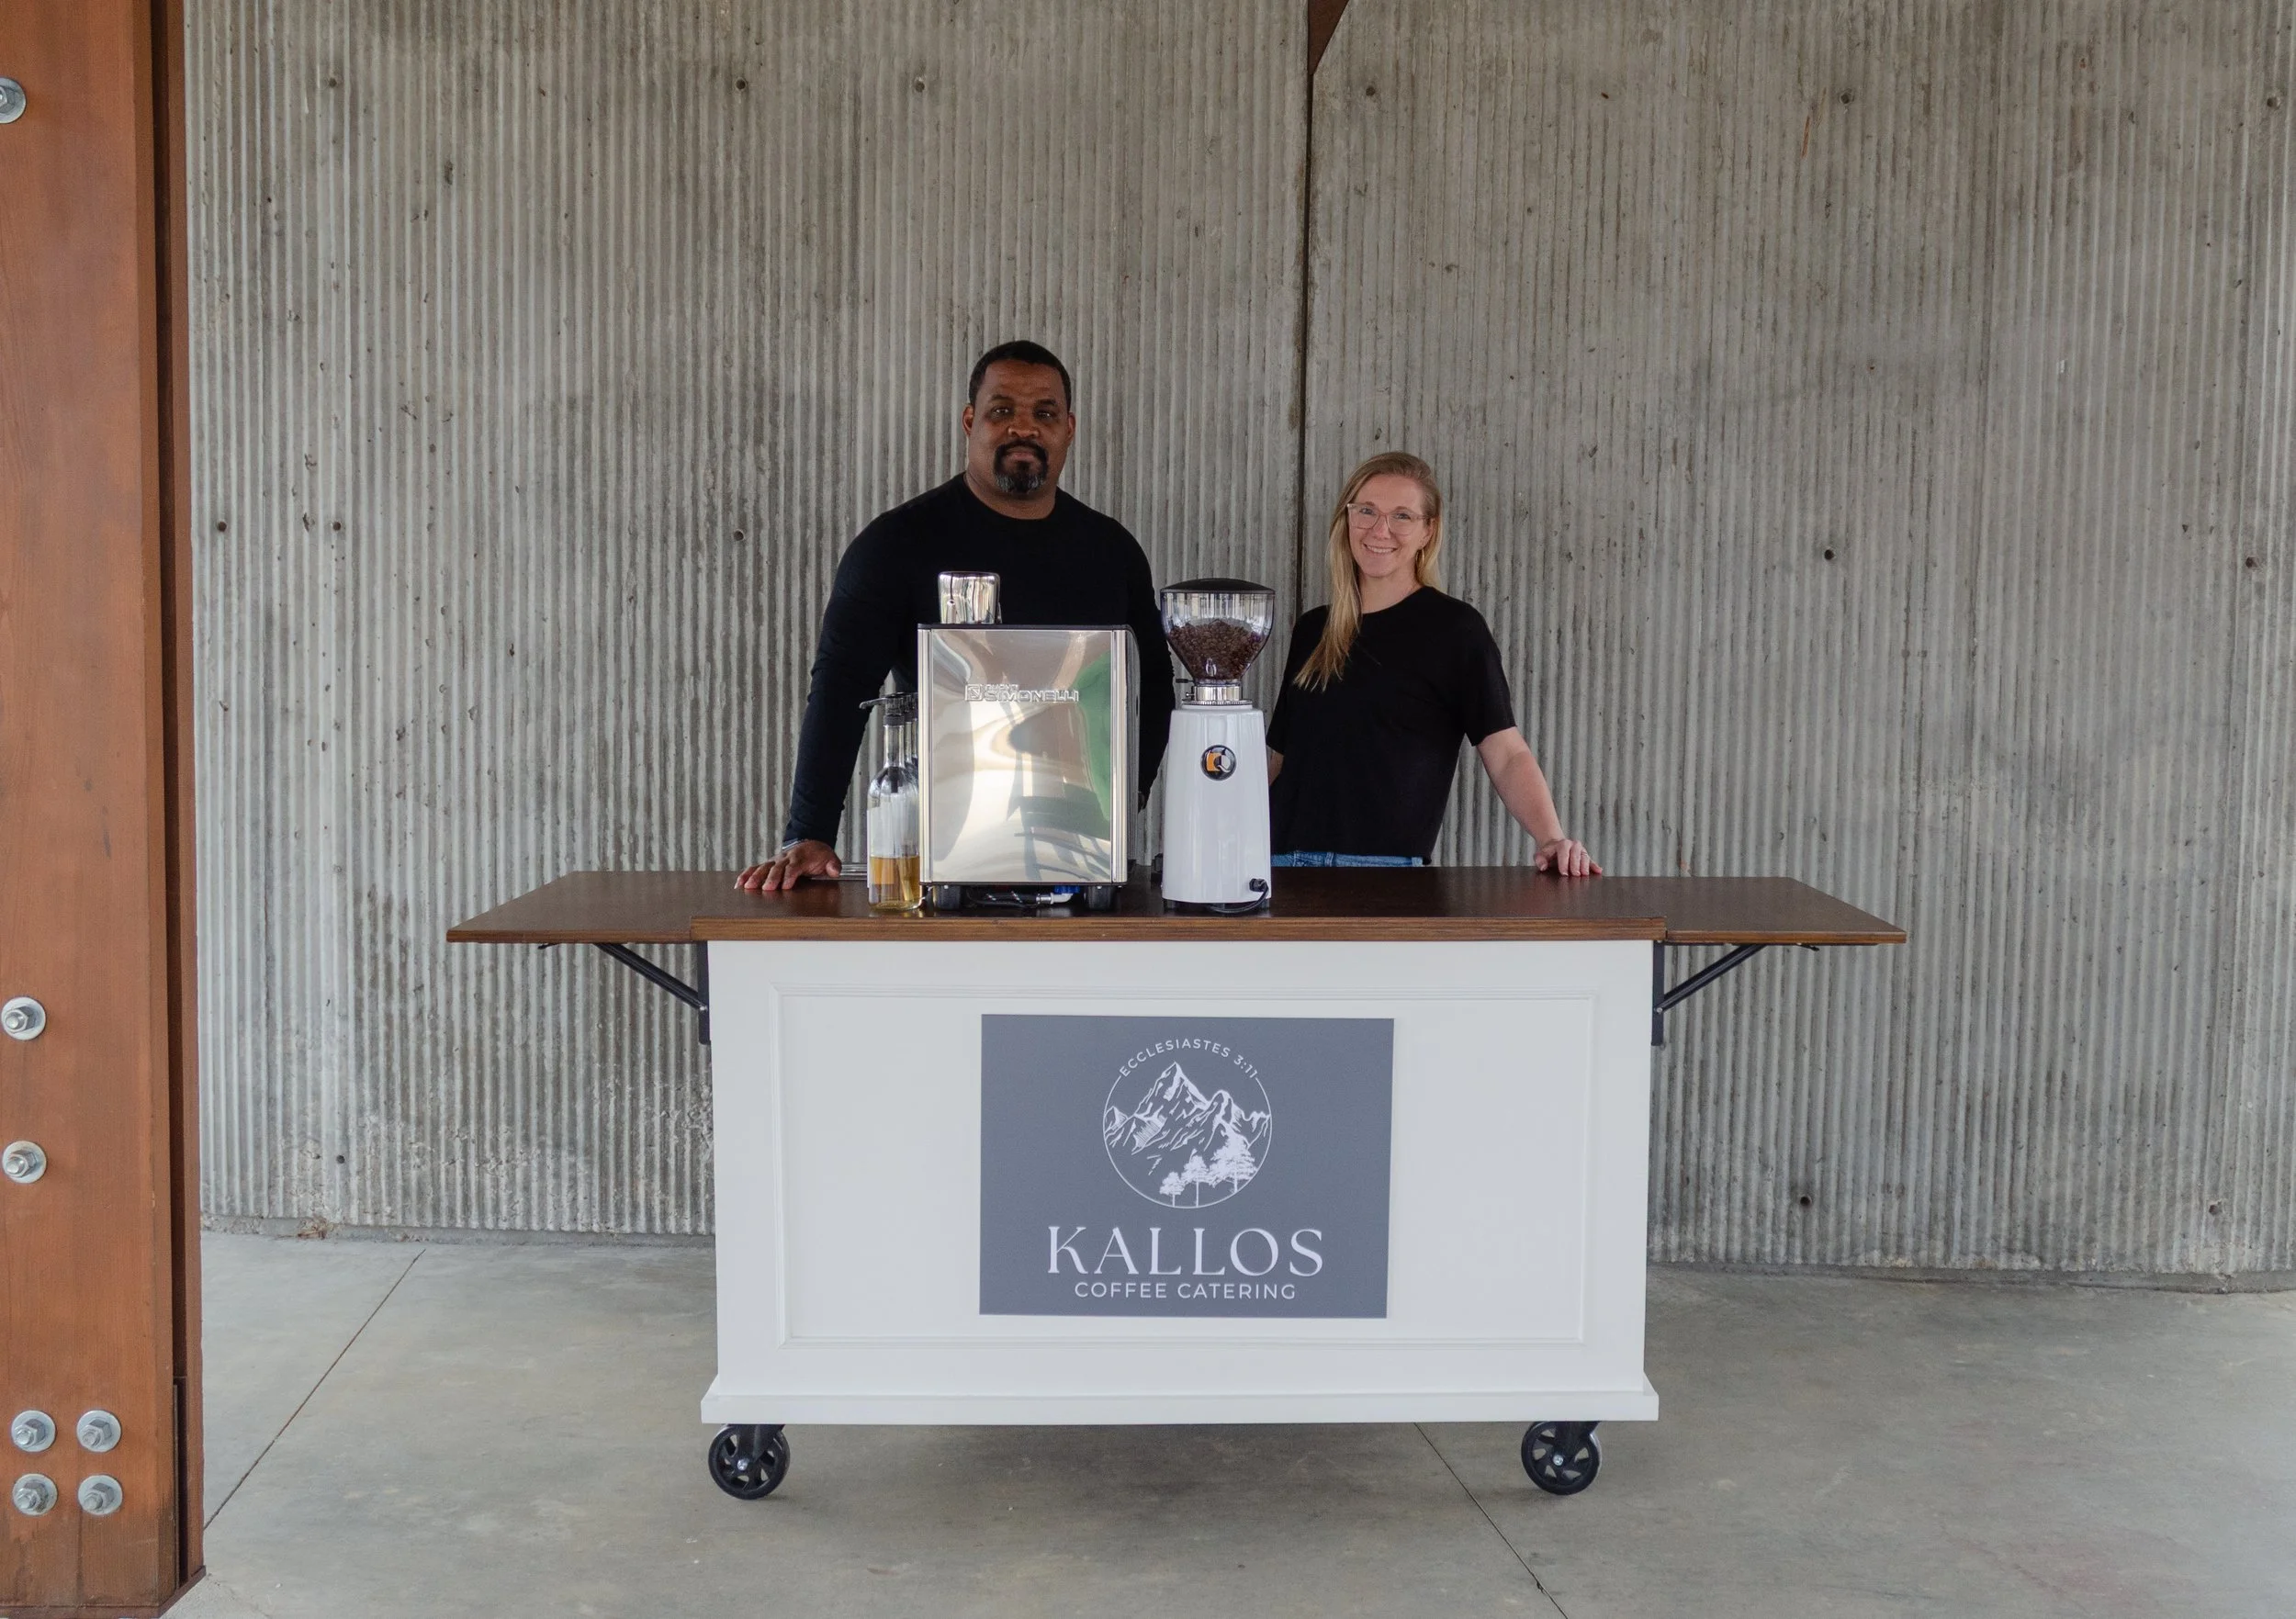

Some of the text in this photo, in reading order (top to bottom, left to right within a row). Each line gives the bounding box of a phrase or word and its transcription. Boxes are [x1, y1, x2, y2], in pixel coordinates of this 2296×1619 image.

[985, 689, 1079, 703] SIMONELLI
[1119, 1038, 1258, 1079] ECCLESIASTES 3:11
[1047, 1225, 1323, 1277] KALLOS
[1074, 1281, 1296, 1300] COFFEE CATERING
